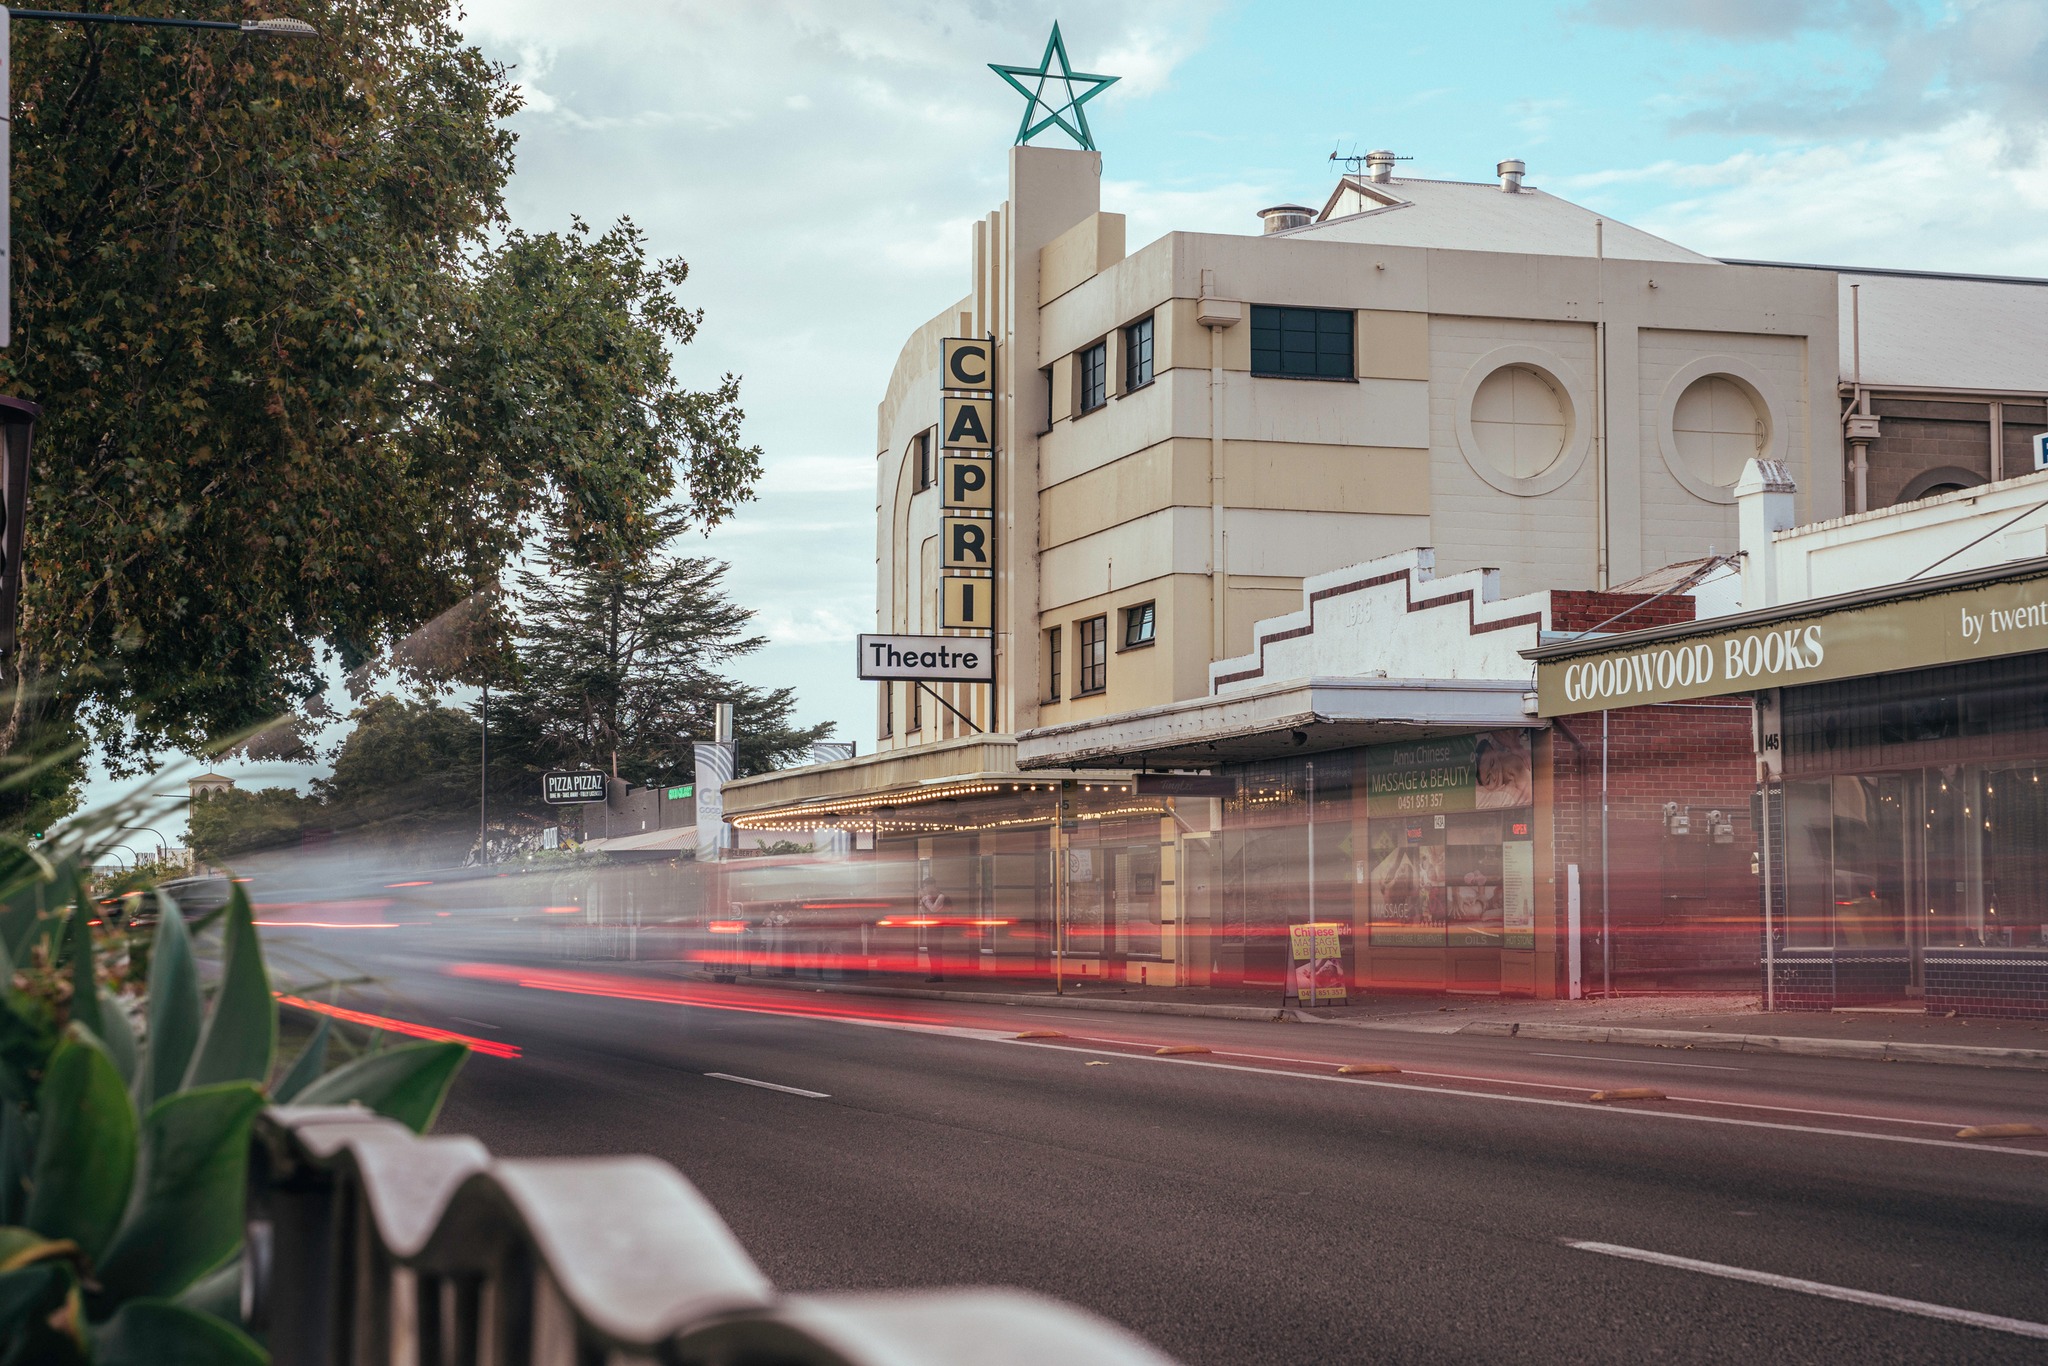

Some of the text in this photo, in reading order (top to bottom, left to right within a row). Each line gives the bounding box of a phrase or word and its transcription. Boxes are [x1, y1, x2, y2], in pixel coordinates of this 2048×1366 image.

[947, 345, 989, 622] CAPRI
[1961, 607, 1985, 645] by
[869, 643, 979, 669] Theatre
[1564, 625, 1824, 702] GOODWOOD BOOKS
[1765, 733, 1779, 751] 145
[1393, 745, 1450, 767] Anna Chinese
[549, 774, 603, 792] PIZZA PIZZAZ
[1372, 766, 1470, 793] MASSAGE & BEAUTY
[1398, 793, 1444, 810] 0451 851 357
[1512, 823, 1528, 835] OPEN
[1465, 935, 1487, 945] OILS
[1303, 946, 1338, 956] BAUTY
